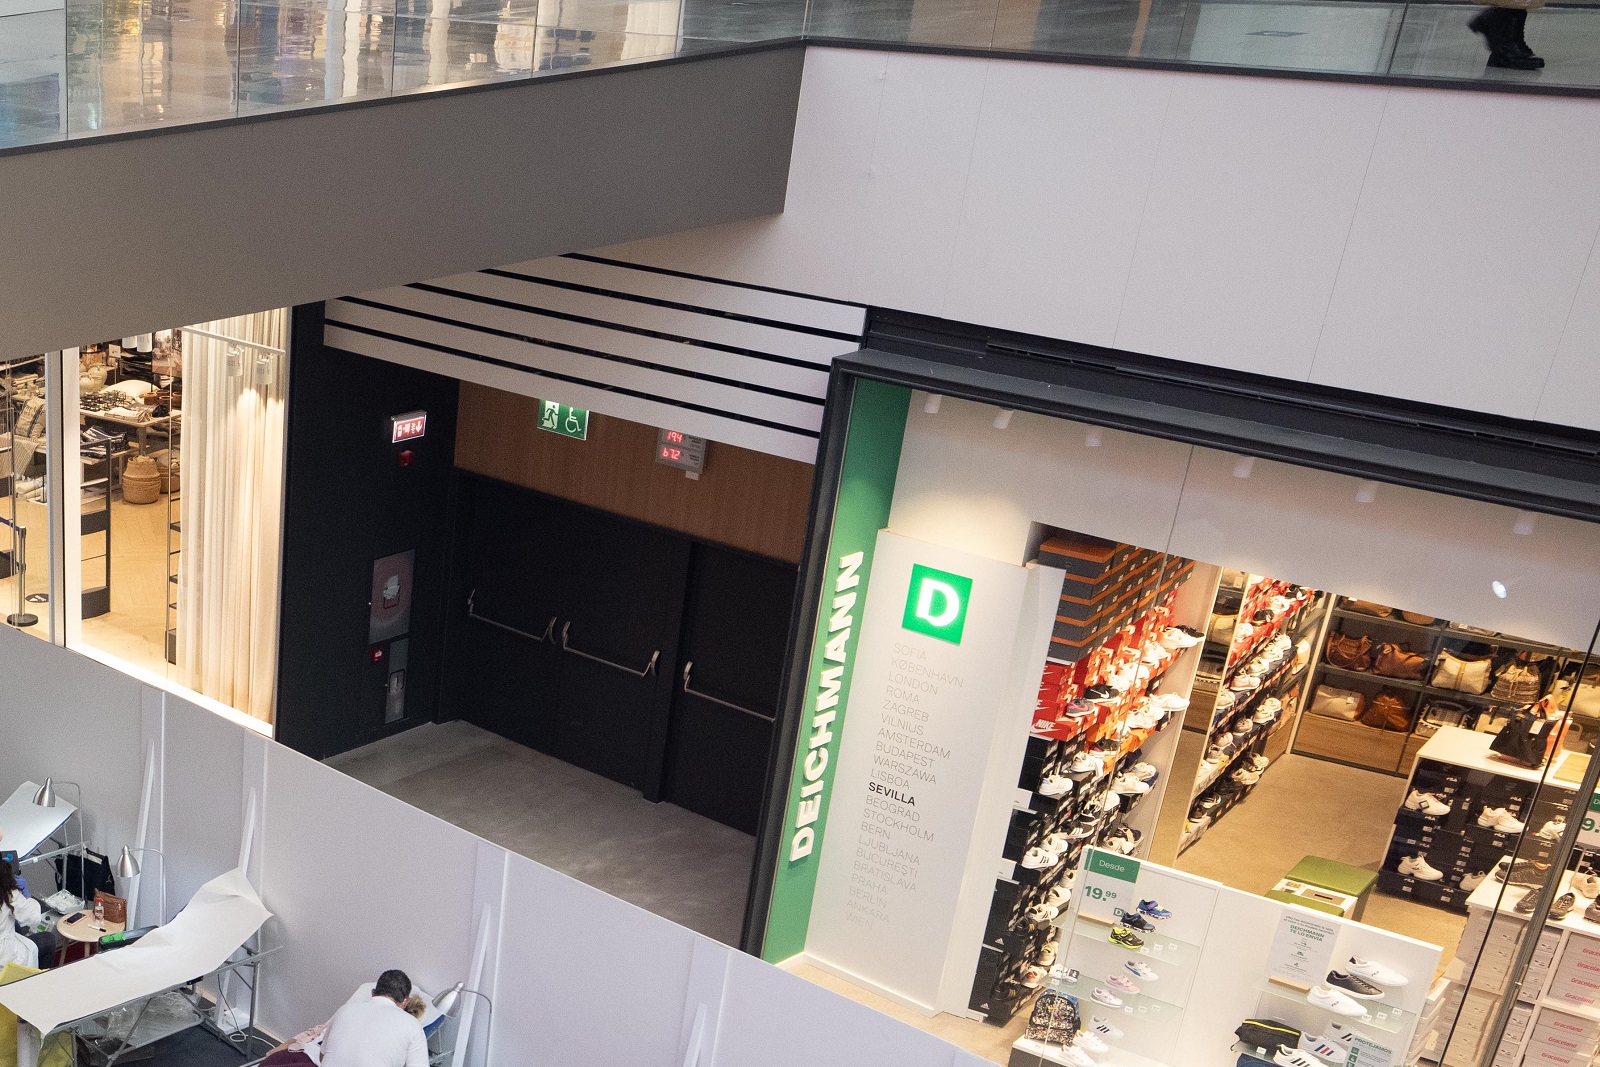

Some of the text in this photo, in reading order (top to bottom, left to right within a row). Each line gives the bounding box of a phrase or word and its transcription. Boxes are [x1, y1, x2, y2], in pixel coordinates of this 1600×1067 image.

[916, 577, 960, 627] D
[893, 642, 928, 662] SOFIA
[888, 672, 939, 695] LONDON
[891, 657, 964, 688] KØBENHAVN
[886, 685, 920, 705] ROMA
[789, 552, 864, 862] DEICHMANN
[882, 699, 930, 723] ZAGREB
[881, 712, 924, 736] VILNIUS
[1035, 719, 1056, 729] NIKE
[878, 728, 951, 759] AMSTERDAM
[875, 741, 936, 769] BUDAPEST
[870, 769, 910, 790] LISBOA
[873, 754, 937, 785] WARSZAWA
[868, 781, 916, 807] SEVILLA
[866, 795, 920, 822] BEOGRAD
[861, 821, 891, 840] BERN
[863, 808, 934, 842] STOCKHOLM
[858, 835, 920, 866] LJUBLJANA
[853, 860, 917, 892] BRATISLAVA
[1098, 860, 1125, 872] Desde
[851, 873, 888, 894] PRAHA
[849, 886, 888, 909] BERLIN
[845, 913, 873, 930] WIEN
[846, 900, 890, 922] ANKARA
[1291, 925, 1324, 938] DEICHMANN
[1565, 992, 1594, 1004] Graceland
[1554, 1021, 1583, 1033] Graceland
[1354, 1037, 1392, 1054] PROTEJAMOS
[1548, 1036, 1578, 1049] Graceland
[1541, 1052, 1570, 1065] Graceland
